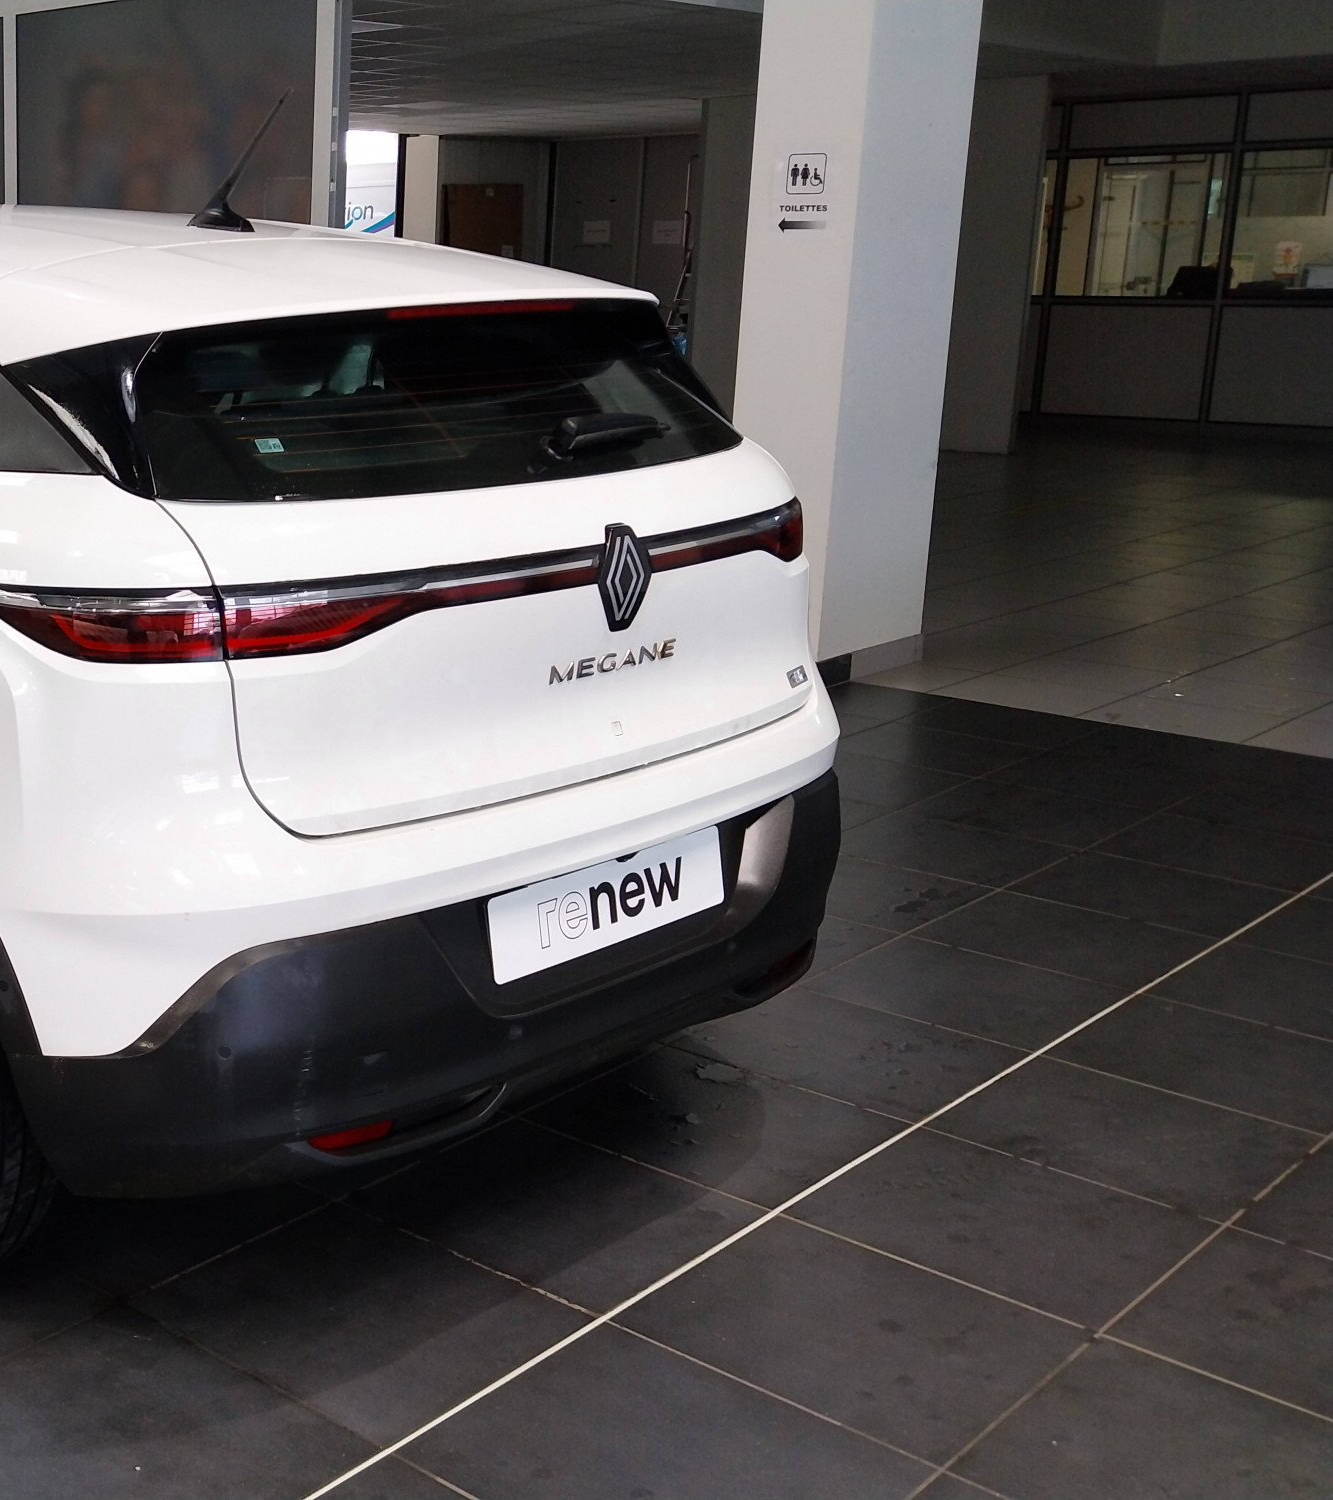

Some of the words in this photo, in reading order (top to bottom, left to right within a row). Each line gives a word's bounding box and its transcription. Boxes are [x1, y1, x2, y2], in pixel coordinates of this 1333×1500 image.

[345, 201, 374, 221] ion
[779, 204, 827, 212] TOILETTES
[549, 638, 677, 685] MEGANE
[537, 856, 682, 949] renew
